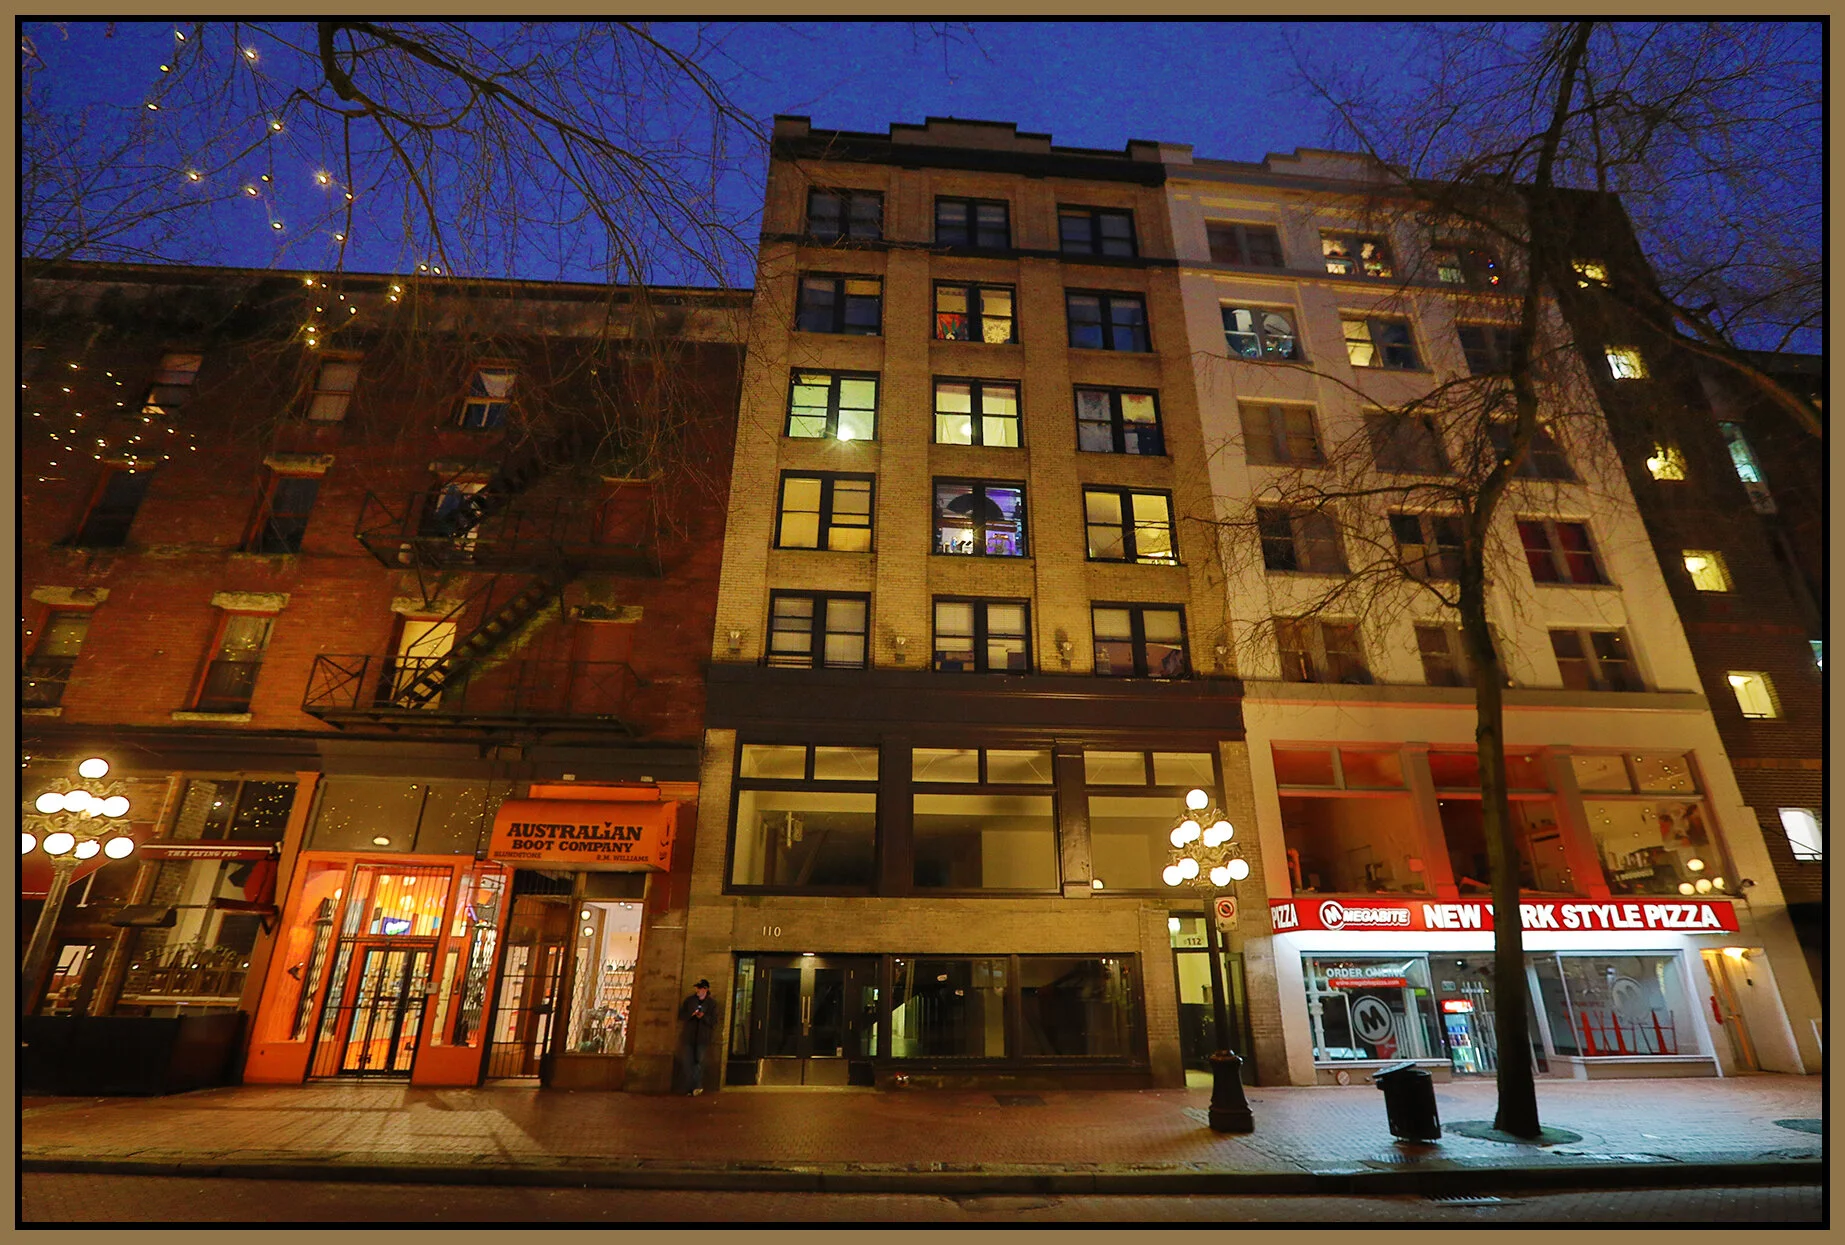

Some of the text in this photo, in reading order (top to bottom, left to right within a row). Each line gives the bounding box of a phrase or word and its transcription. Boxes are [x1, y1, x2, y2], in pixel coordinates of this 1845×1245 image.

[512, 839, 633, 853] BOOT COMPANY
[1271, 903, 1299, 929] PIZZA
[1343, 908, 1409, 924] MEGABITE
[1422, 904, 1482, 929] NEW
[1561, 904, 1644, 929] STYLE
[1643, 904, 1722, 928] PIZZA
[762, 926, 781, 937] 110
[1326, 968, 1363, 978] ORDER
